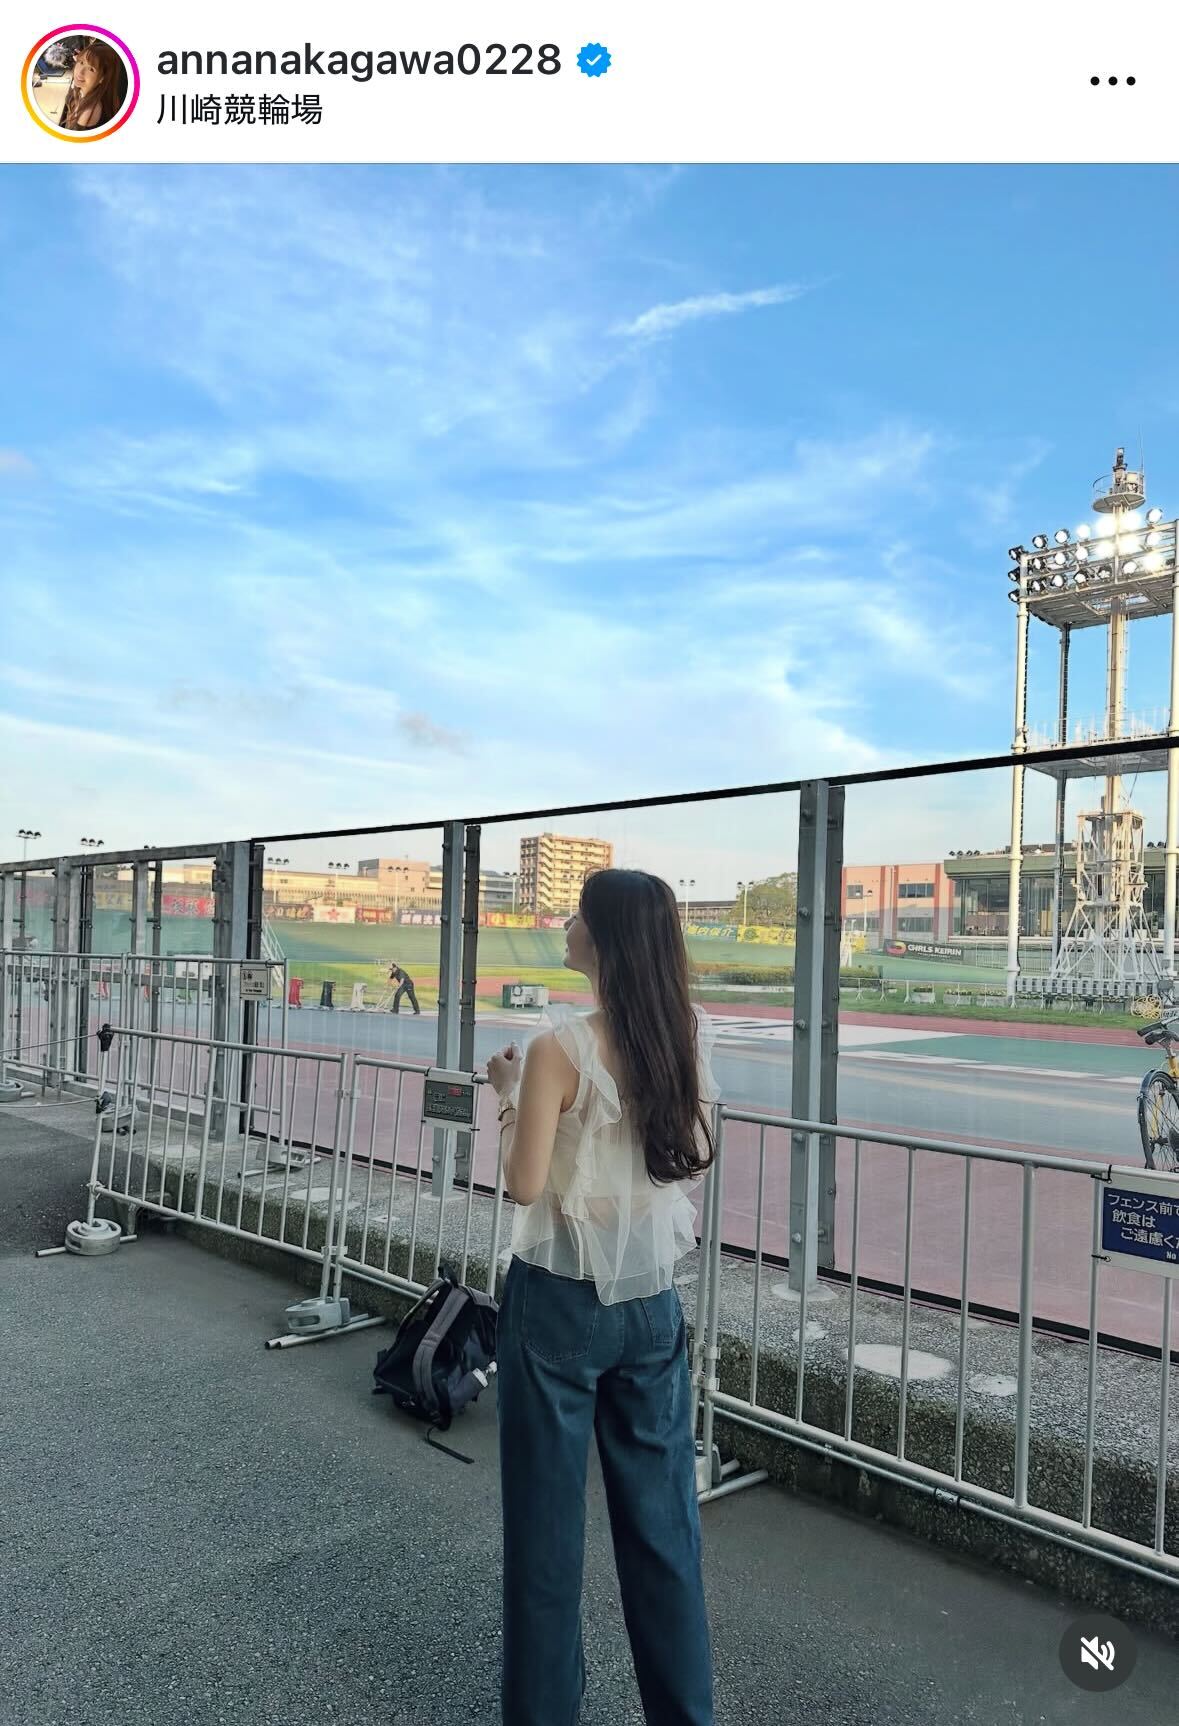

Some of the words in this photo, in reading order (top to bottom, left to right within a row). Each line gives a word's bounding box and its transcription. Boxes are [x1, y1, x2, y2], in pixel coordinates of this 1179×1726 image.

[907, 944, 933, 953] GIRLS
[934, 947, 962, 956] KEIRIN
[1112, 1208, 1156, 1228] 飲食は
